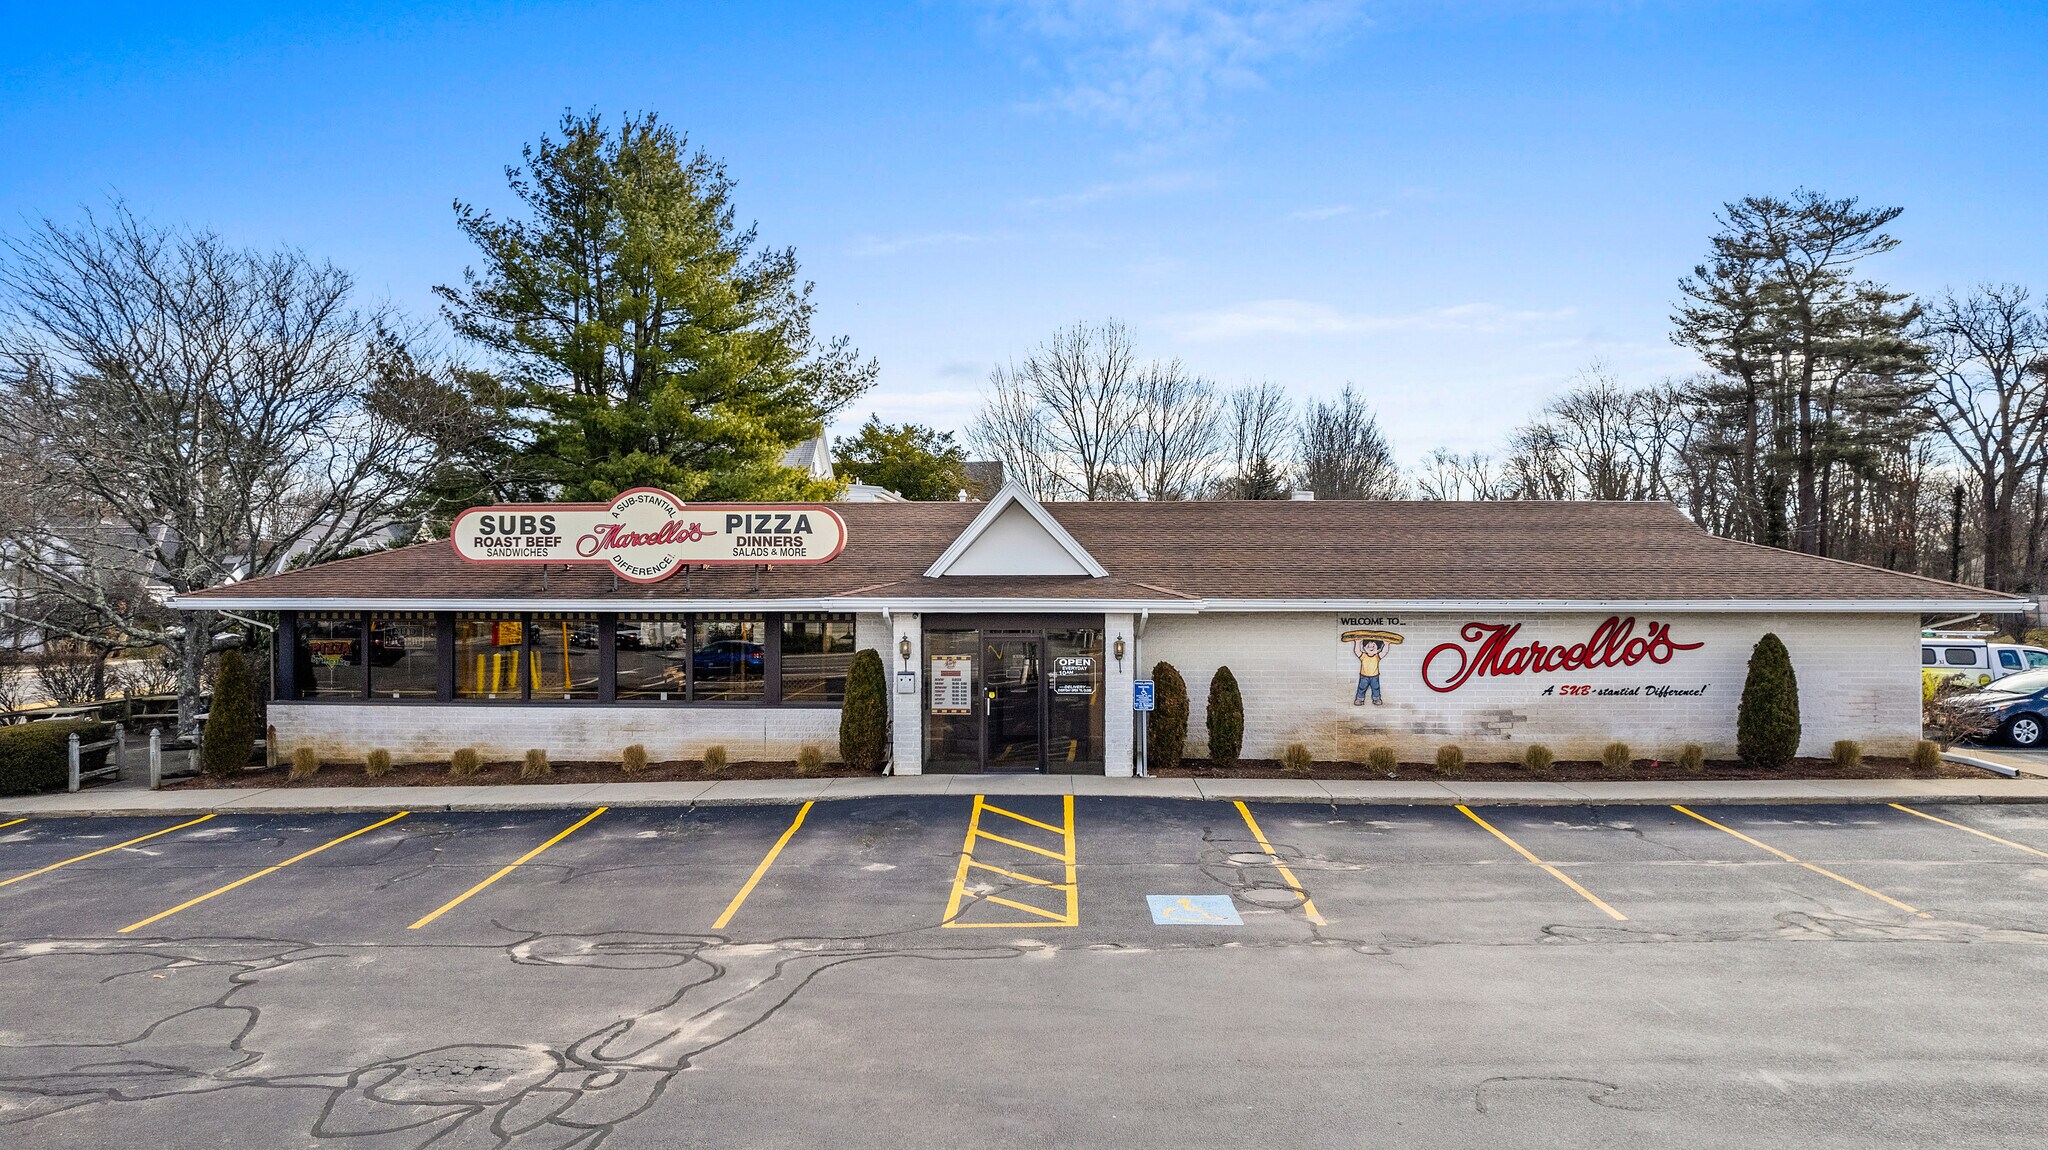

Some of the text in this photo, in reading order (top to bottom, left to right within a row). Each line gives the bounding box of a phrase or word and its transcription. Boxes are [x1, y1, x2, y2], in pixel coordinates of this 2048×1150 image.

[612, 494, 677, 519] A SUB-STANTIAL
[479, 515, 556, 536] SUBS
[726, 514, 813, 534] PIZZA
[474, 536, 562, 548] ROAST BEEF
[575, 519, 718, 558] Marcello's
[736, 536, 804, 547] DINNERS
[486, 547, 549, 557] SANDWICHES
[732, 547, 807, 557] SALADS & MORE
[612, 553, 676, 576] DIFFERENCE!
[1340, 617, 1384, 626] WELCOME
[1421, 616, 1705, 693] Marcello's
[1059, 658, 1091, 666] OPEN
[1541, 684, 1707, 698] A SUB-stantial Difference!
